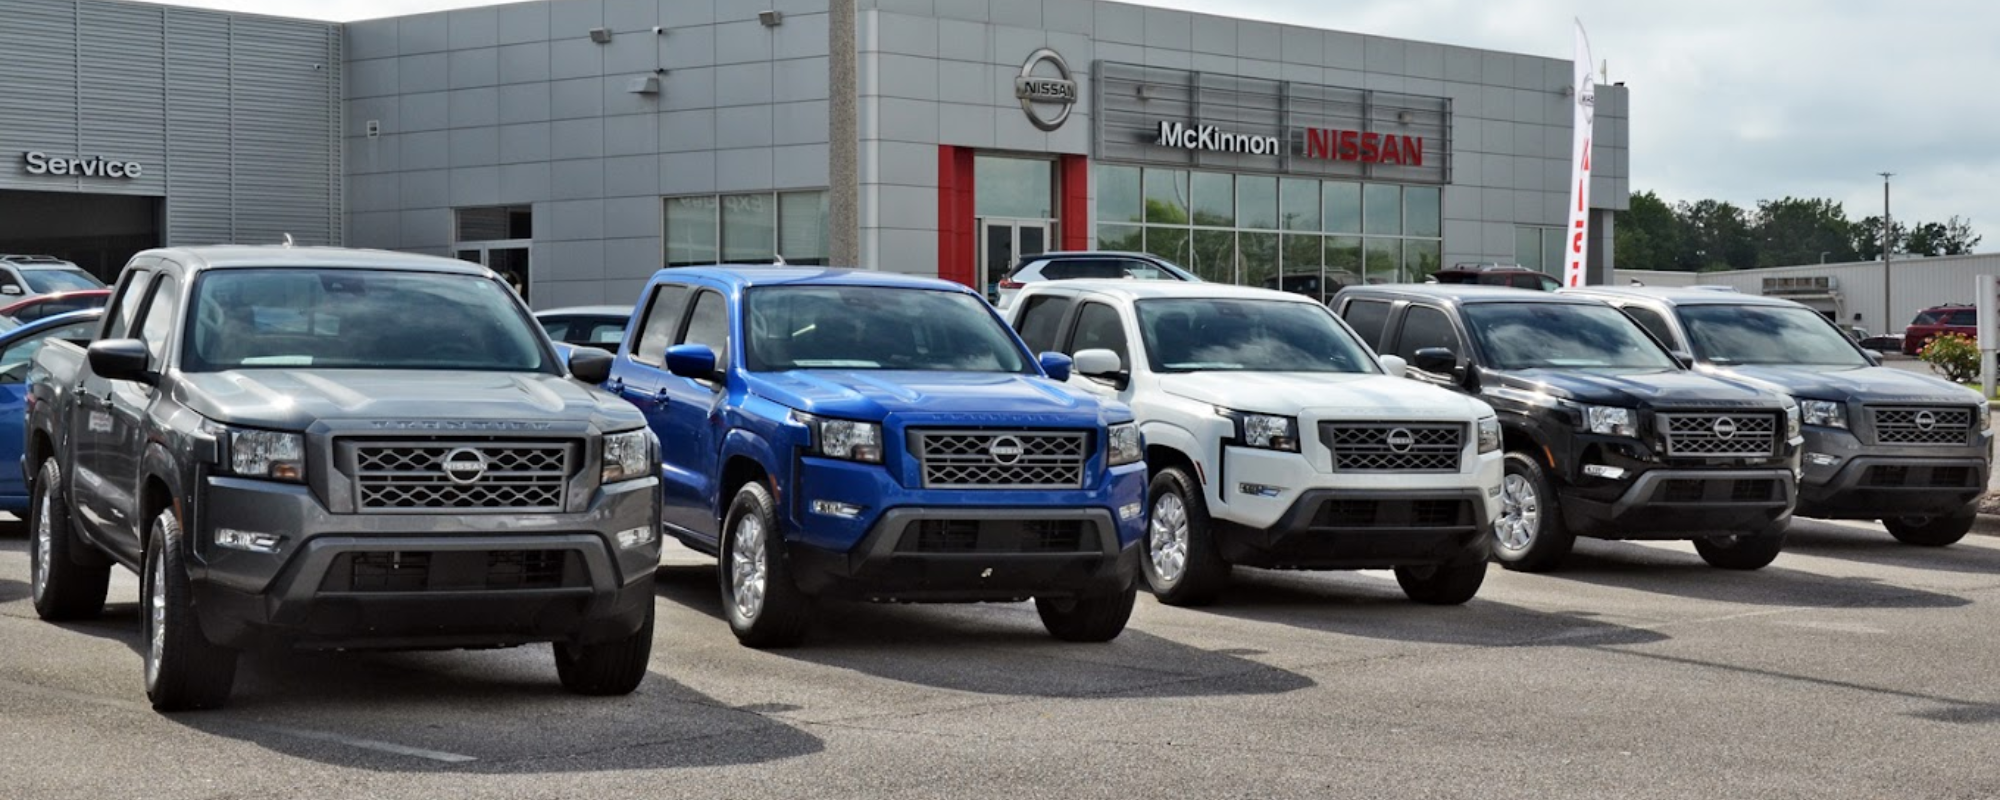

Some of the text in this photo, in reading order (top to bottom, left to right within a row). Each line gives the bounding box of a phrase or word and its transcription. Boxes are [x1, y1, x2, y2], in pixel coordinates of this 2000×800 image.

[1024, 81, 1075, 98] NISSAN
[1159, 120, 1423, 167] McKinnon NISSAN
[25, 151, 142, 179] Service
[442, 461, 488, 470] NISSAN
